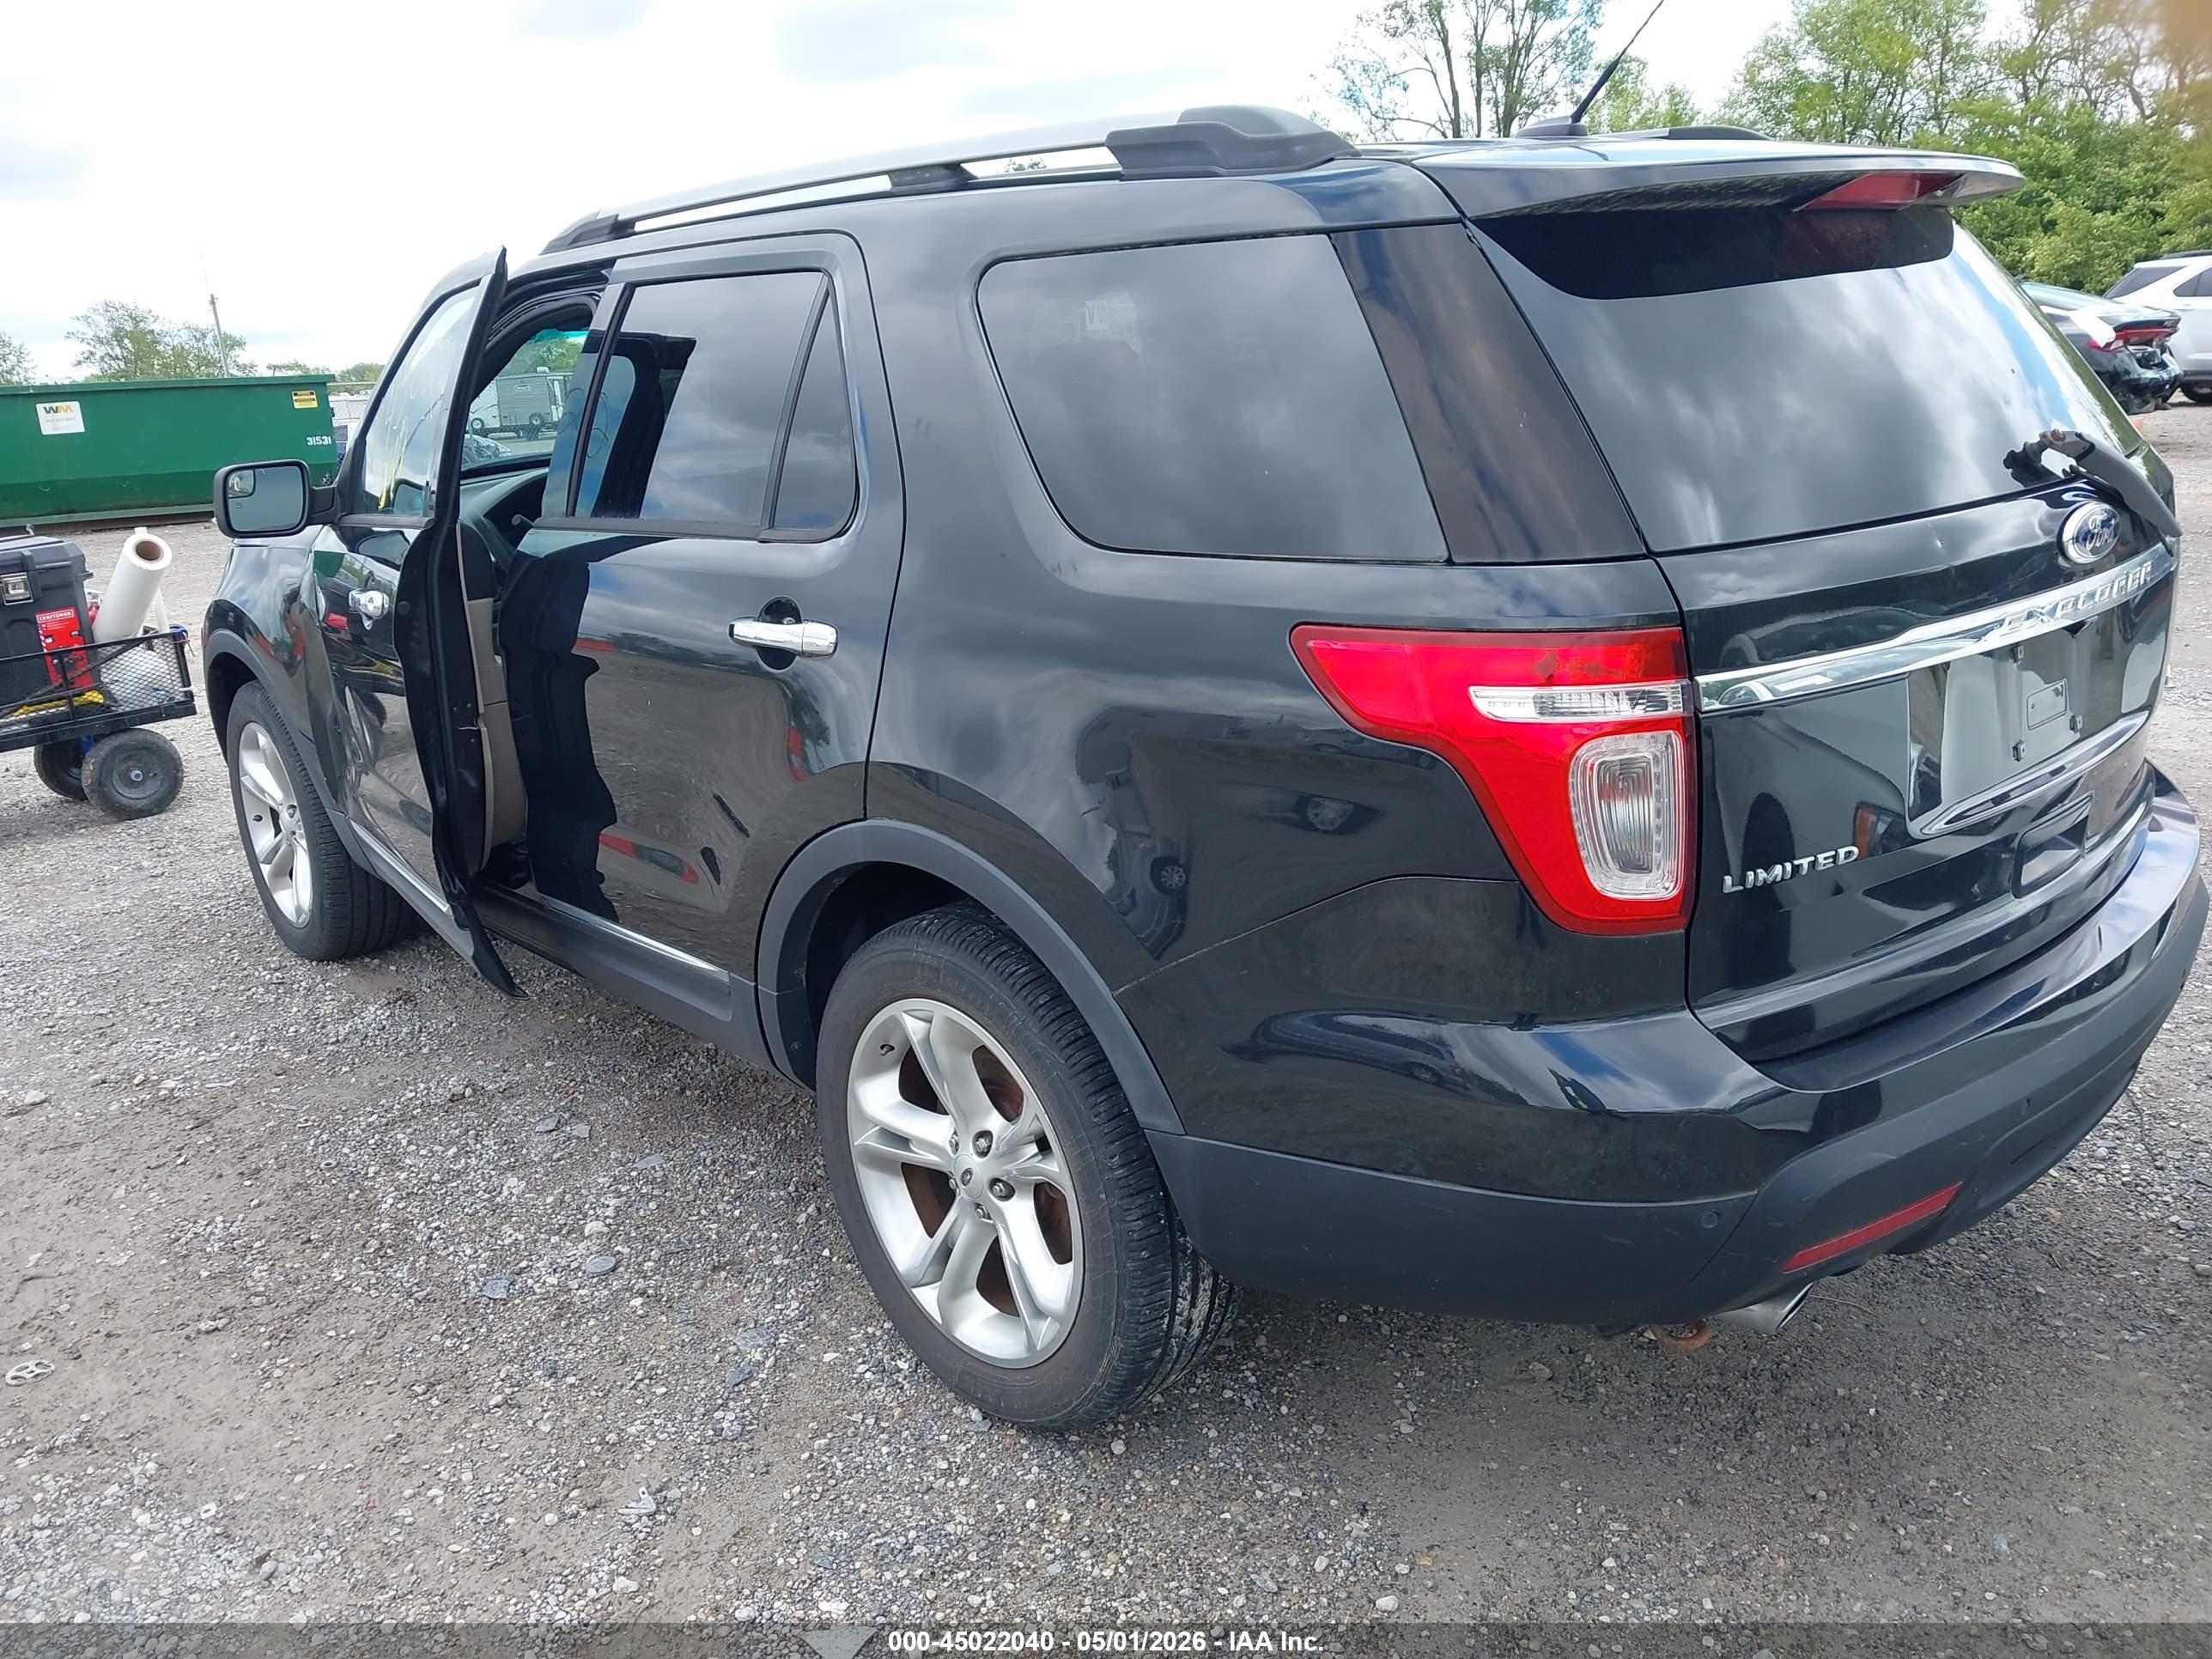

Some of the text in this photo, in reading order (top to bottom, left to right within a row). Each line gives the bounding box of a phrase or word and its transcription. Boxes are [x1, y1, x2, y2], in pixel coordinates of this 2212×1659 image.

[43, 404, 74, 414] WM
[307, 435, 331, 446] 31531
[2086, 514, 2118, 551] Ford
[2002, 561, 2153, 635] EXPLORER
[39, 611, 71, 622] CRAFTSMAN
[1723, 845, 1859, 893] LIMITED
